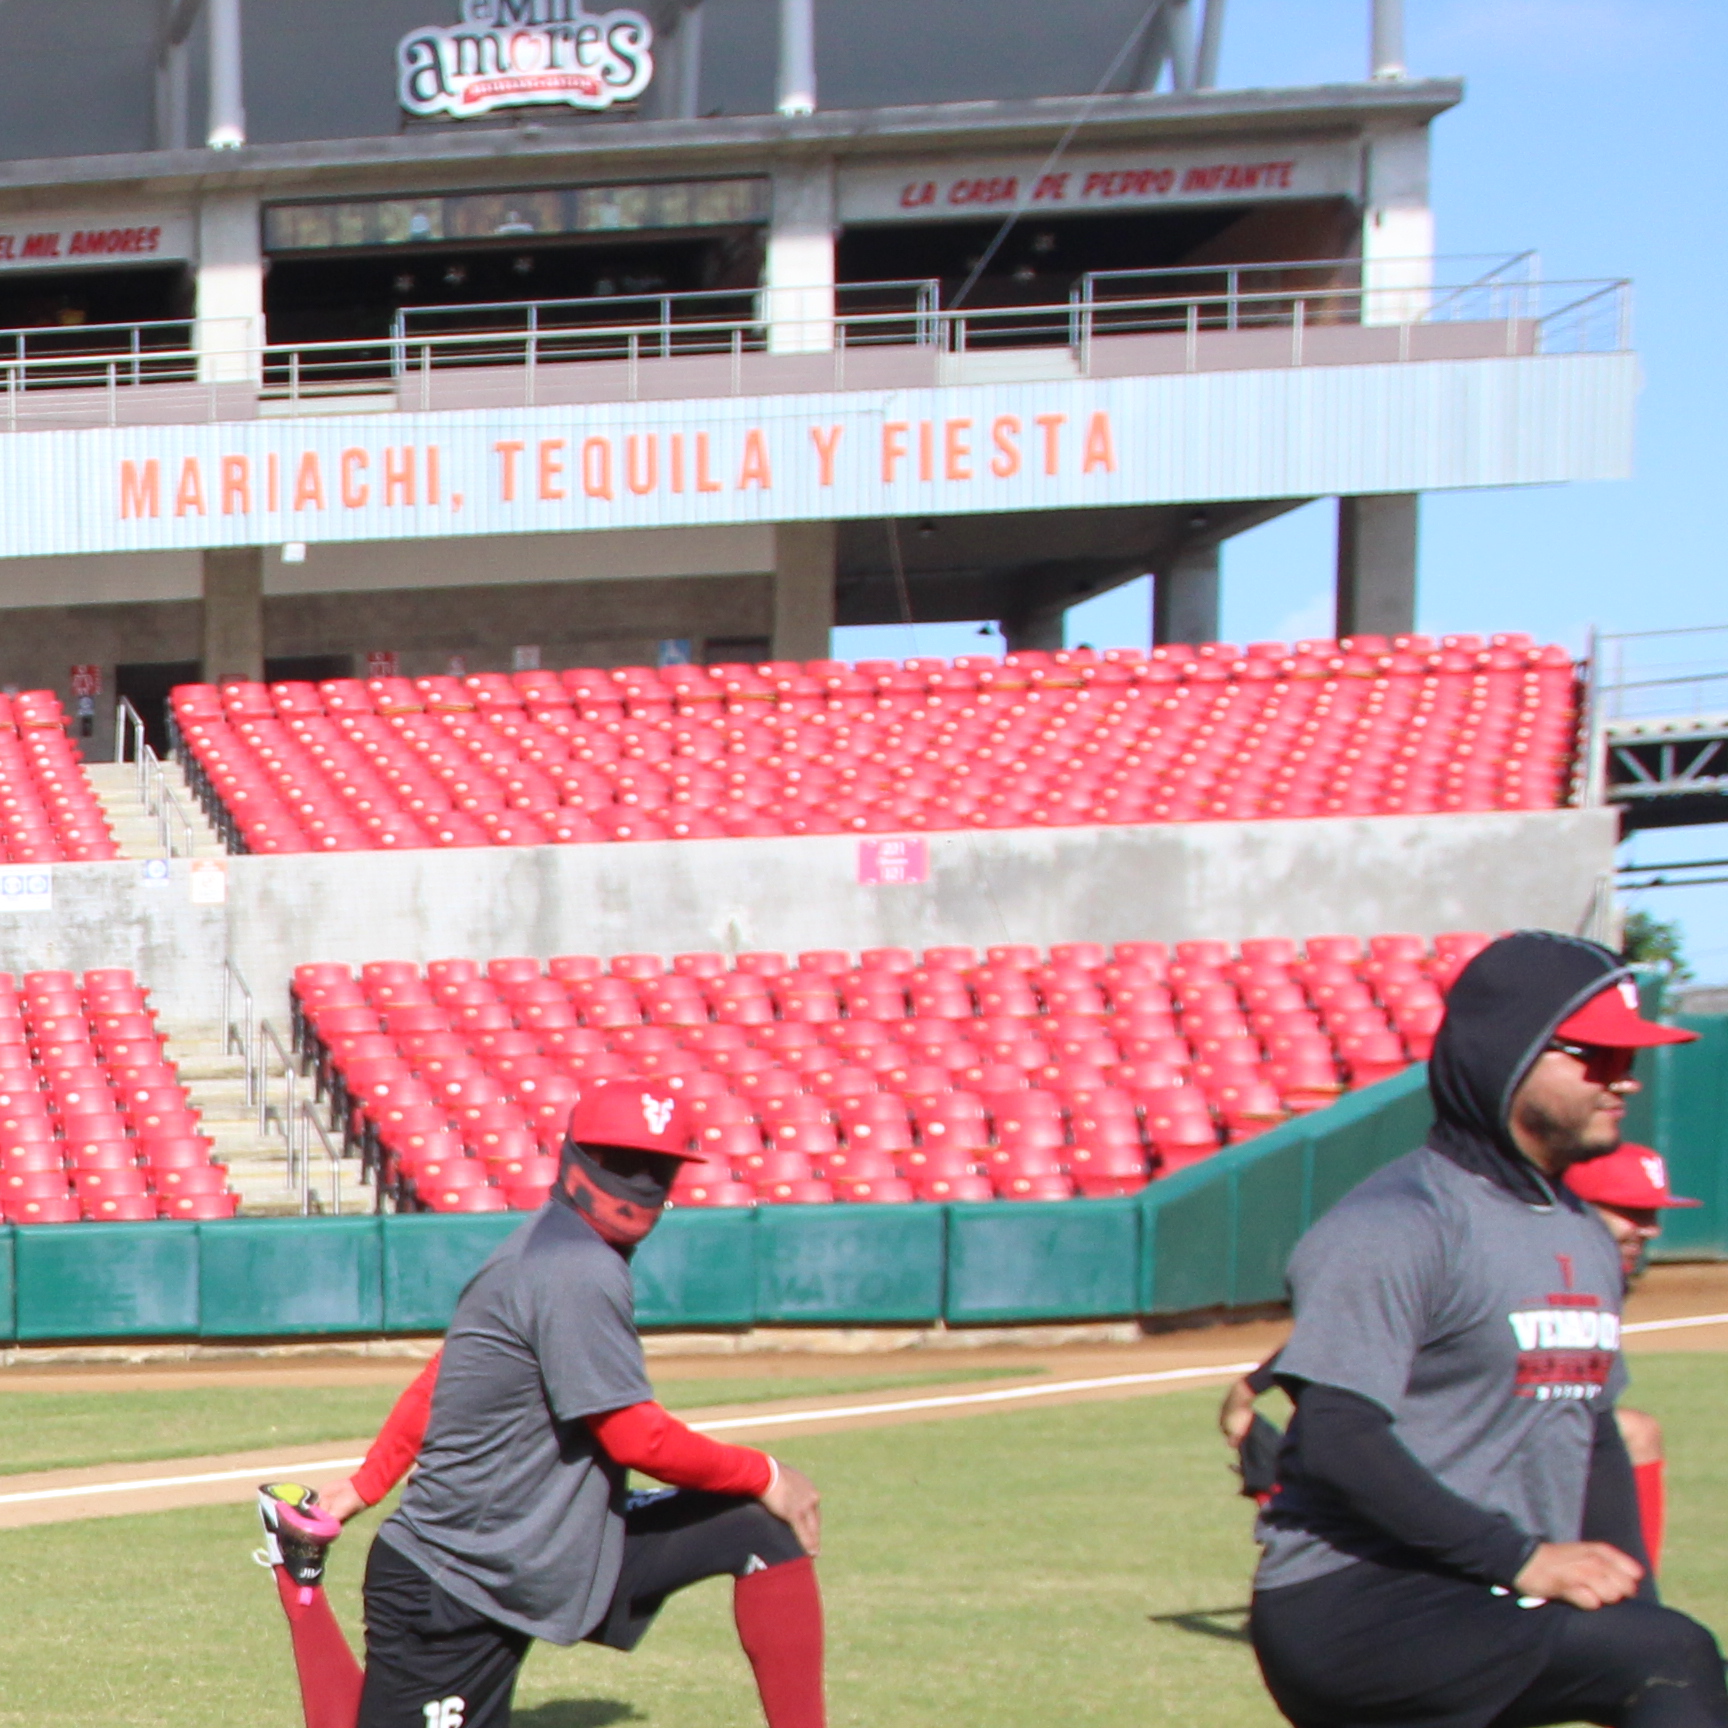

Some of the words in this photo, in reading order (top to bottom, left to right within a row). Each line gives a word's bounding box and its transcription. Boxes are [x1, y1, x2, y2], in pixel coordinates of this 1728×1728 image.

[406, 20, 640, 102] amores
[900, 181, 937, 208] LA
[948, 175, 1019, 205] CASA
[1031, 172, 1072, 200] DE
[1081, 167, 1176, 198] PEDRO
[1180, 160, 1296, 193] INFANTE
[19, 232, 63, 259] MIL
[67, 226, 162, 257] AMORES
[120, 443, 465, 520] MARIACHI,
[493, 428, 773, 503] TEQUILA
[808, 424, 844, 487] Y
[882, 410, 1117, 484] FIESTA
